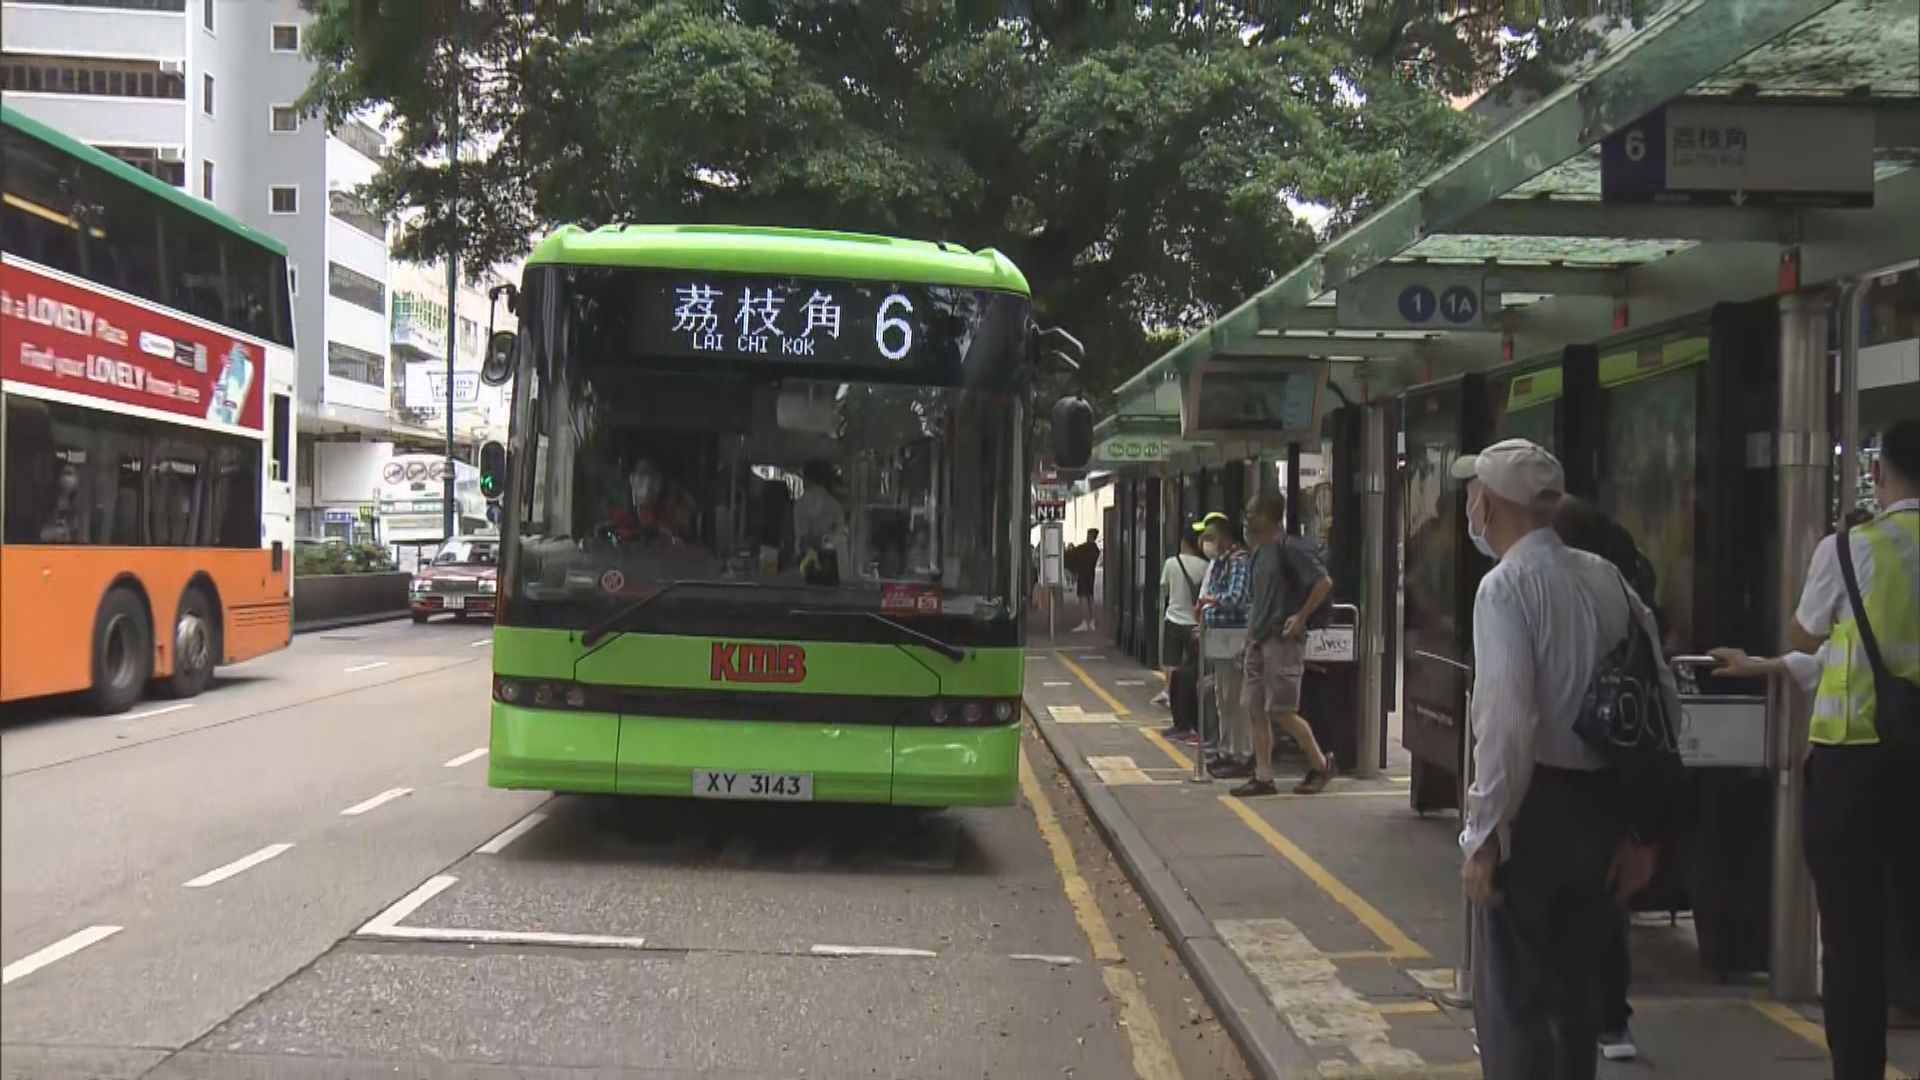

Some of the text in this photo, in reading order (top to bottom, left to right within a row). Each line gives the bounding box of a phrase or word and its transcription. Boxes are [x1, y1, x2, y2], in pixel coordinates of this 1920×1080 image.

[1625, 131, 1646, 161] 6
[27, 293, 95, 337] LOVELY
[672, 283, 840, 339] 荔枝角
[1411, 292, 1422, 313] 1
[1446, 293, 1472, 313] 1A
[693, 332, 815, 355] LAI CHI KOK
[876, 294, 913, 360] 6
[87, 353, 145, 391] LOVELY
[710, 640, 807, 684] KMB
[707, 772, 801, 796] XY 3143
